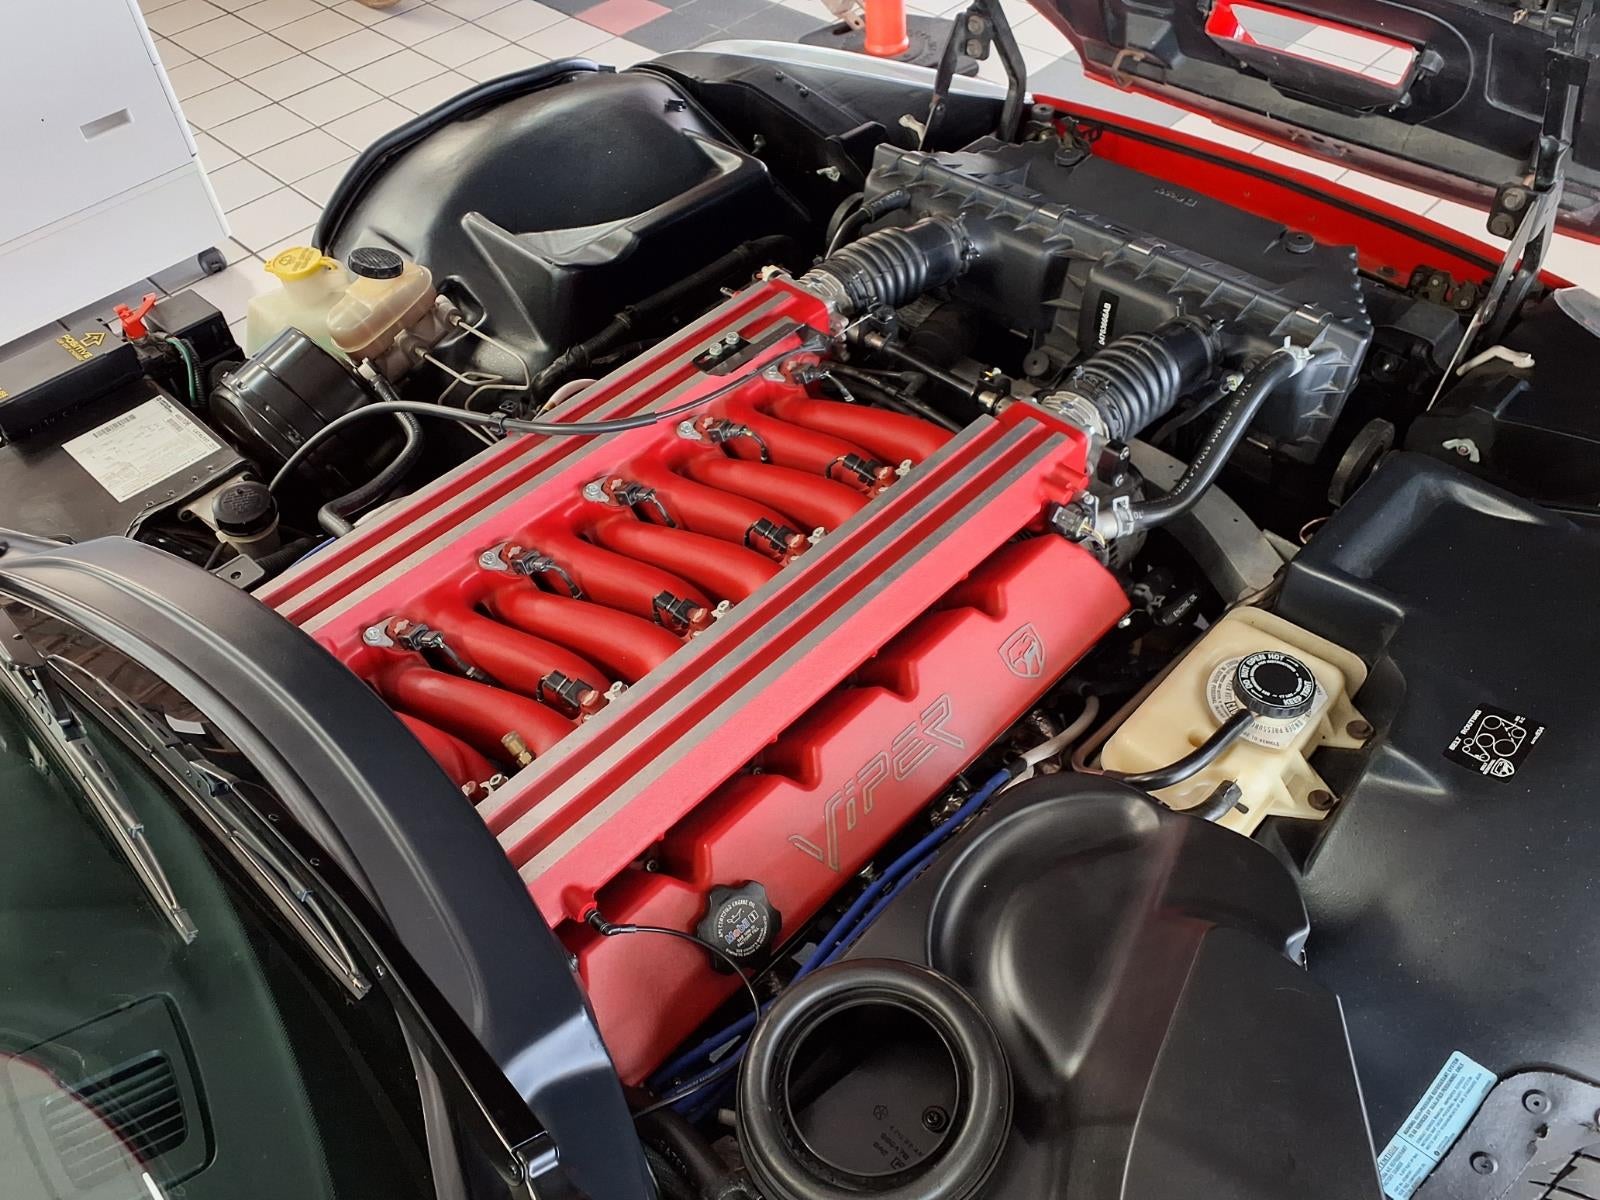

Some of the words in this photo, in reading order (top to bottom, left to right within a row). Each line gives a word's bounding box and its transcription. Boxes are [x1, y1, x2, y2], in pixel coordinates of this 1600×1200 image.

[64, 333, 92, 360] POSITIVE
[1245, 653, 1266, 665] OPEN
[1240, 664, 1250, 678] NOT
[1242, 678, 1253, 689] DO
[1282, 695, 1302, 705] KEEP
[1460, 709, 1482, 735] ROUTING
[788, 693, 966, 873] VIPER
[732, 899, 748, 908] ENGINE
[724, 917, 750, 944] Mobil
